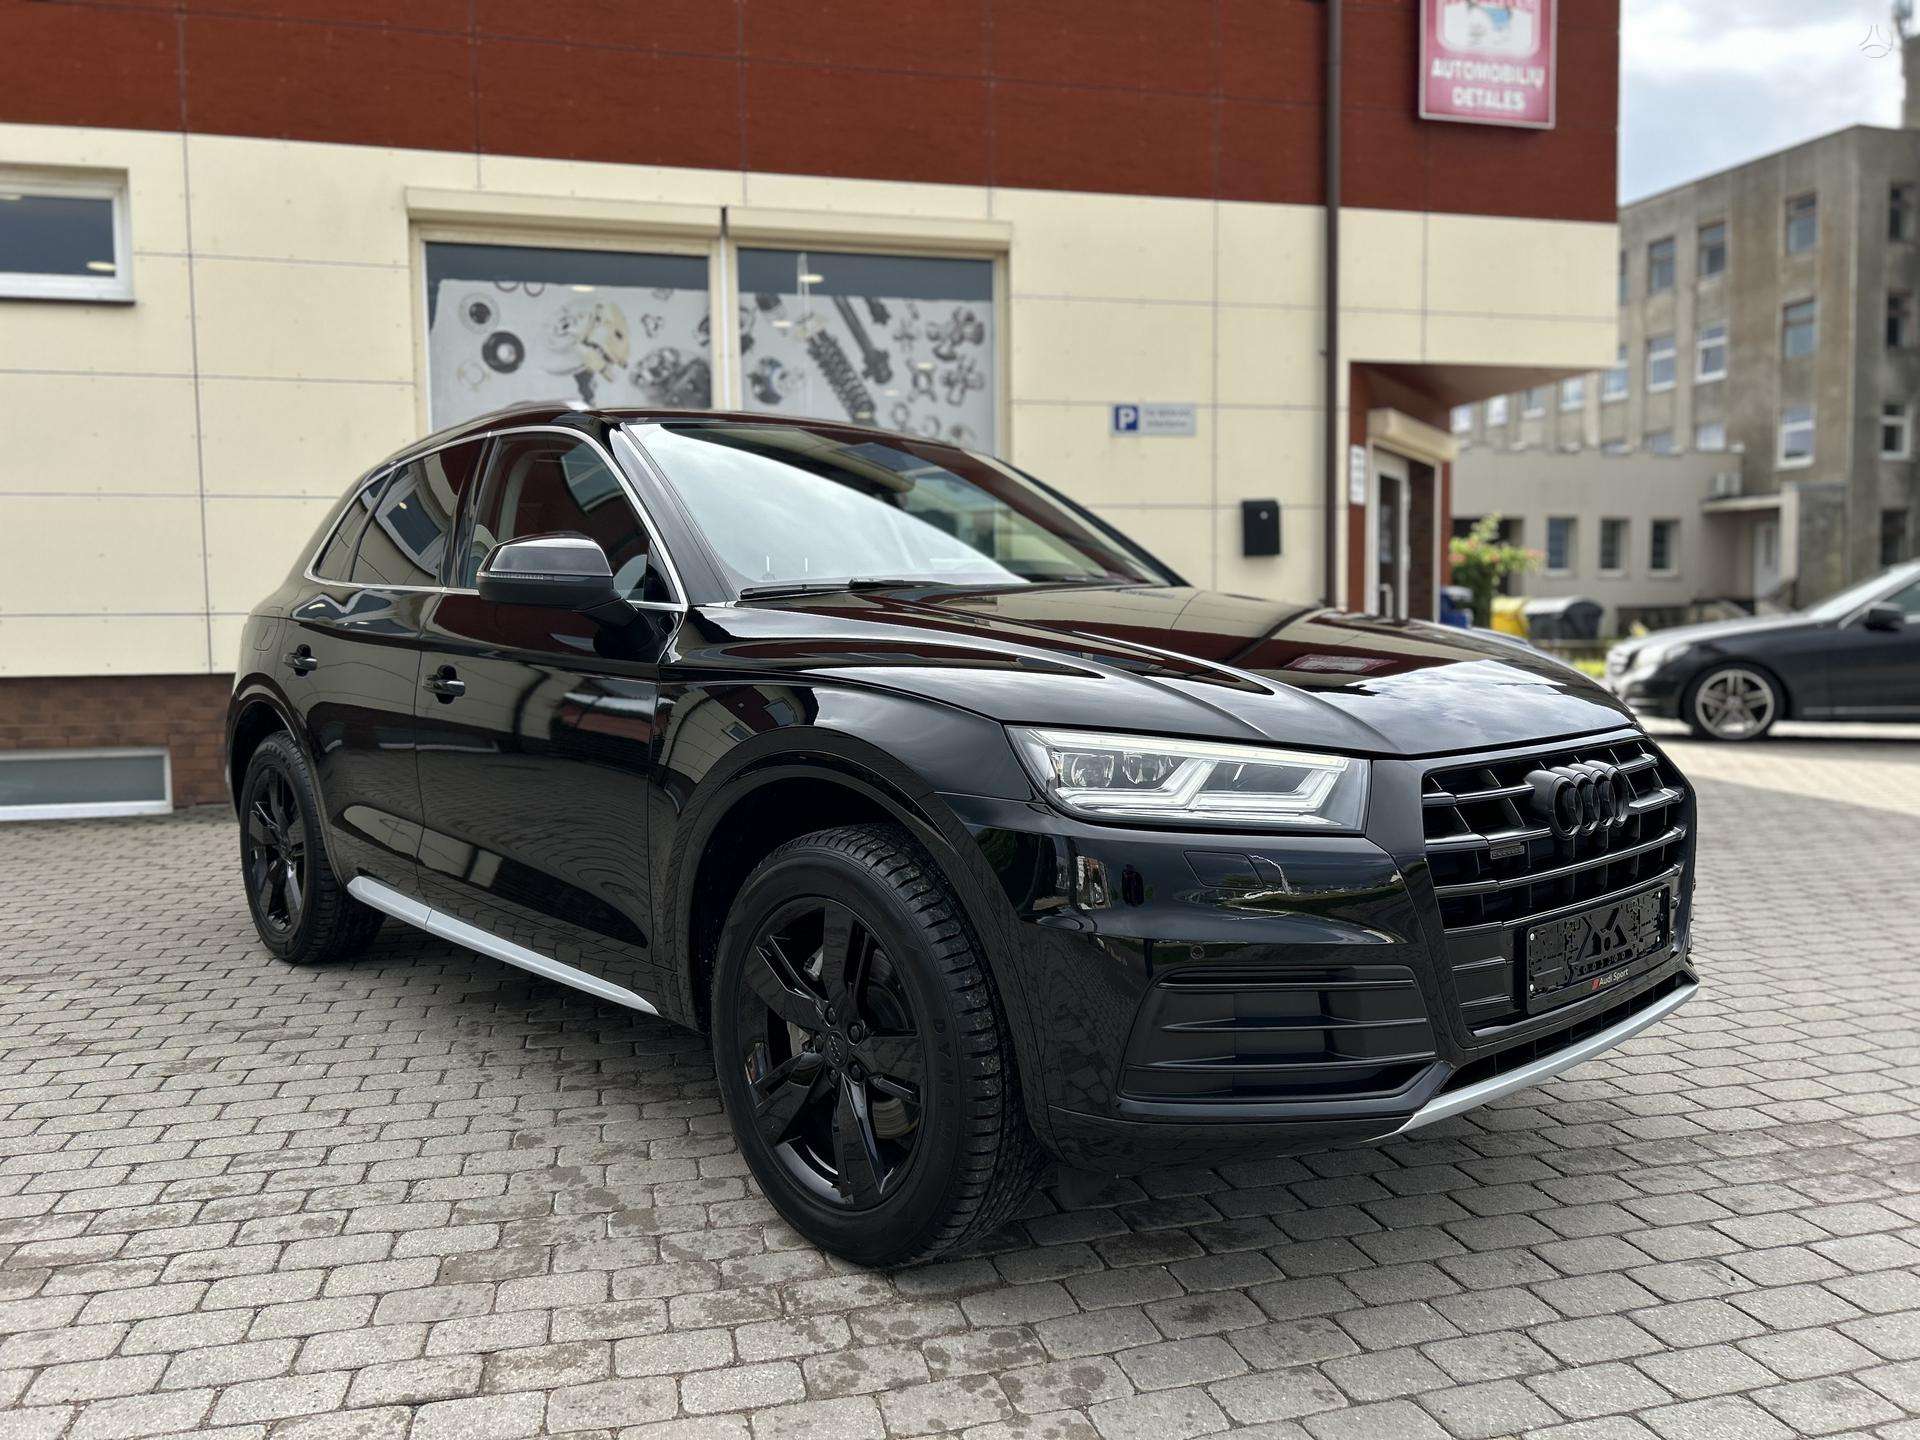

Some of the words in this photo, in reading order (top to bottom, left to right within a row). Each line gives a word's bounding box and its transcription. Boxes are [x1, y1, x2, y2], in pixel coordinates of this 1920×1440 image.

[1119, 408, 1137, 430] P
[1599, 973, 1613, 986] Audi
[1613, 968, 1629, 981] Sport
